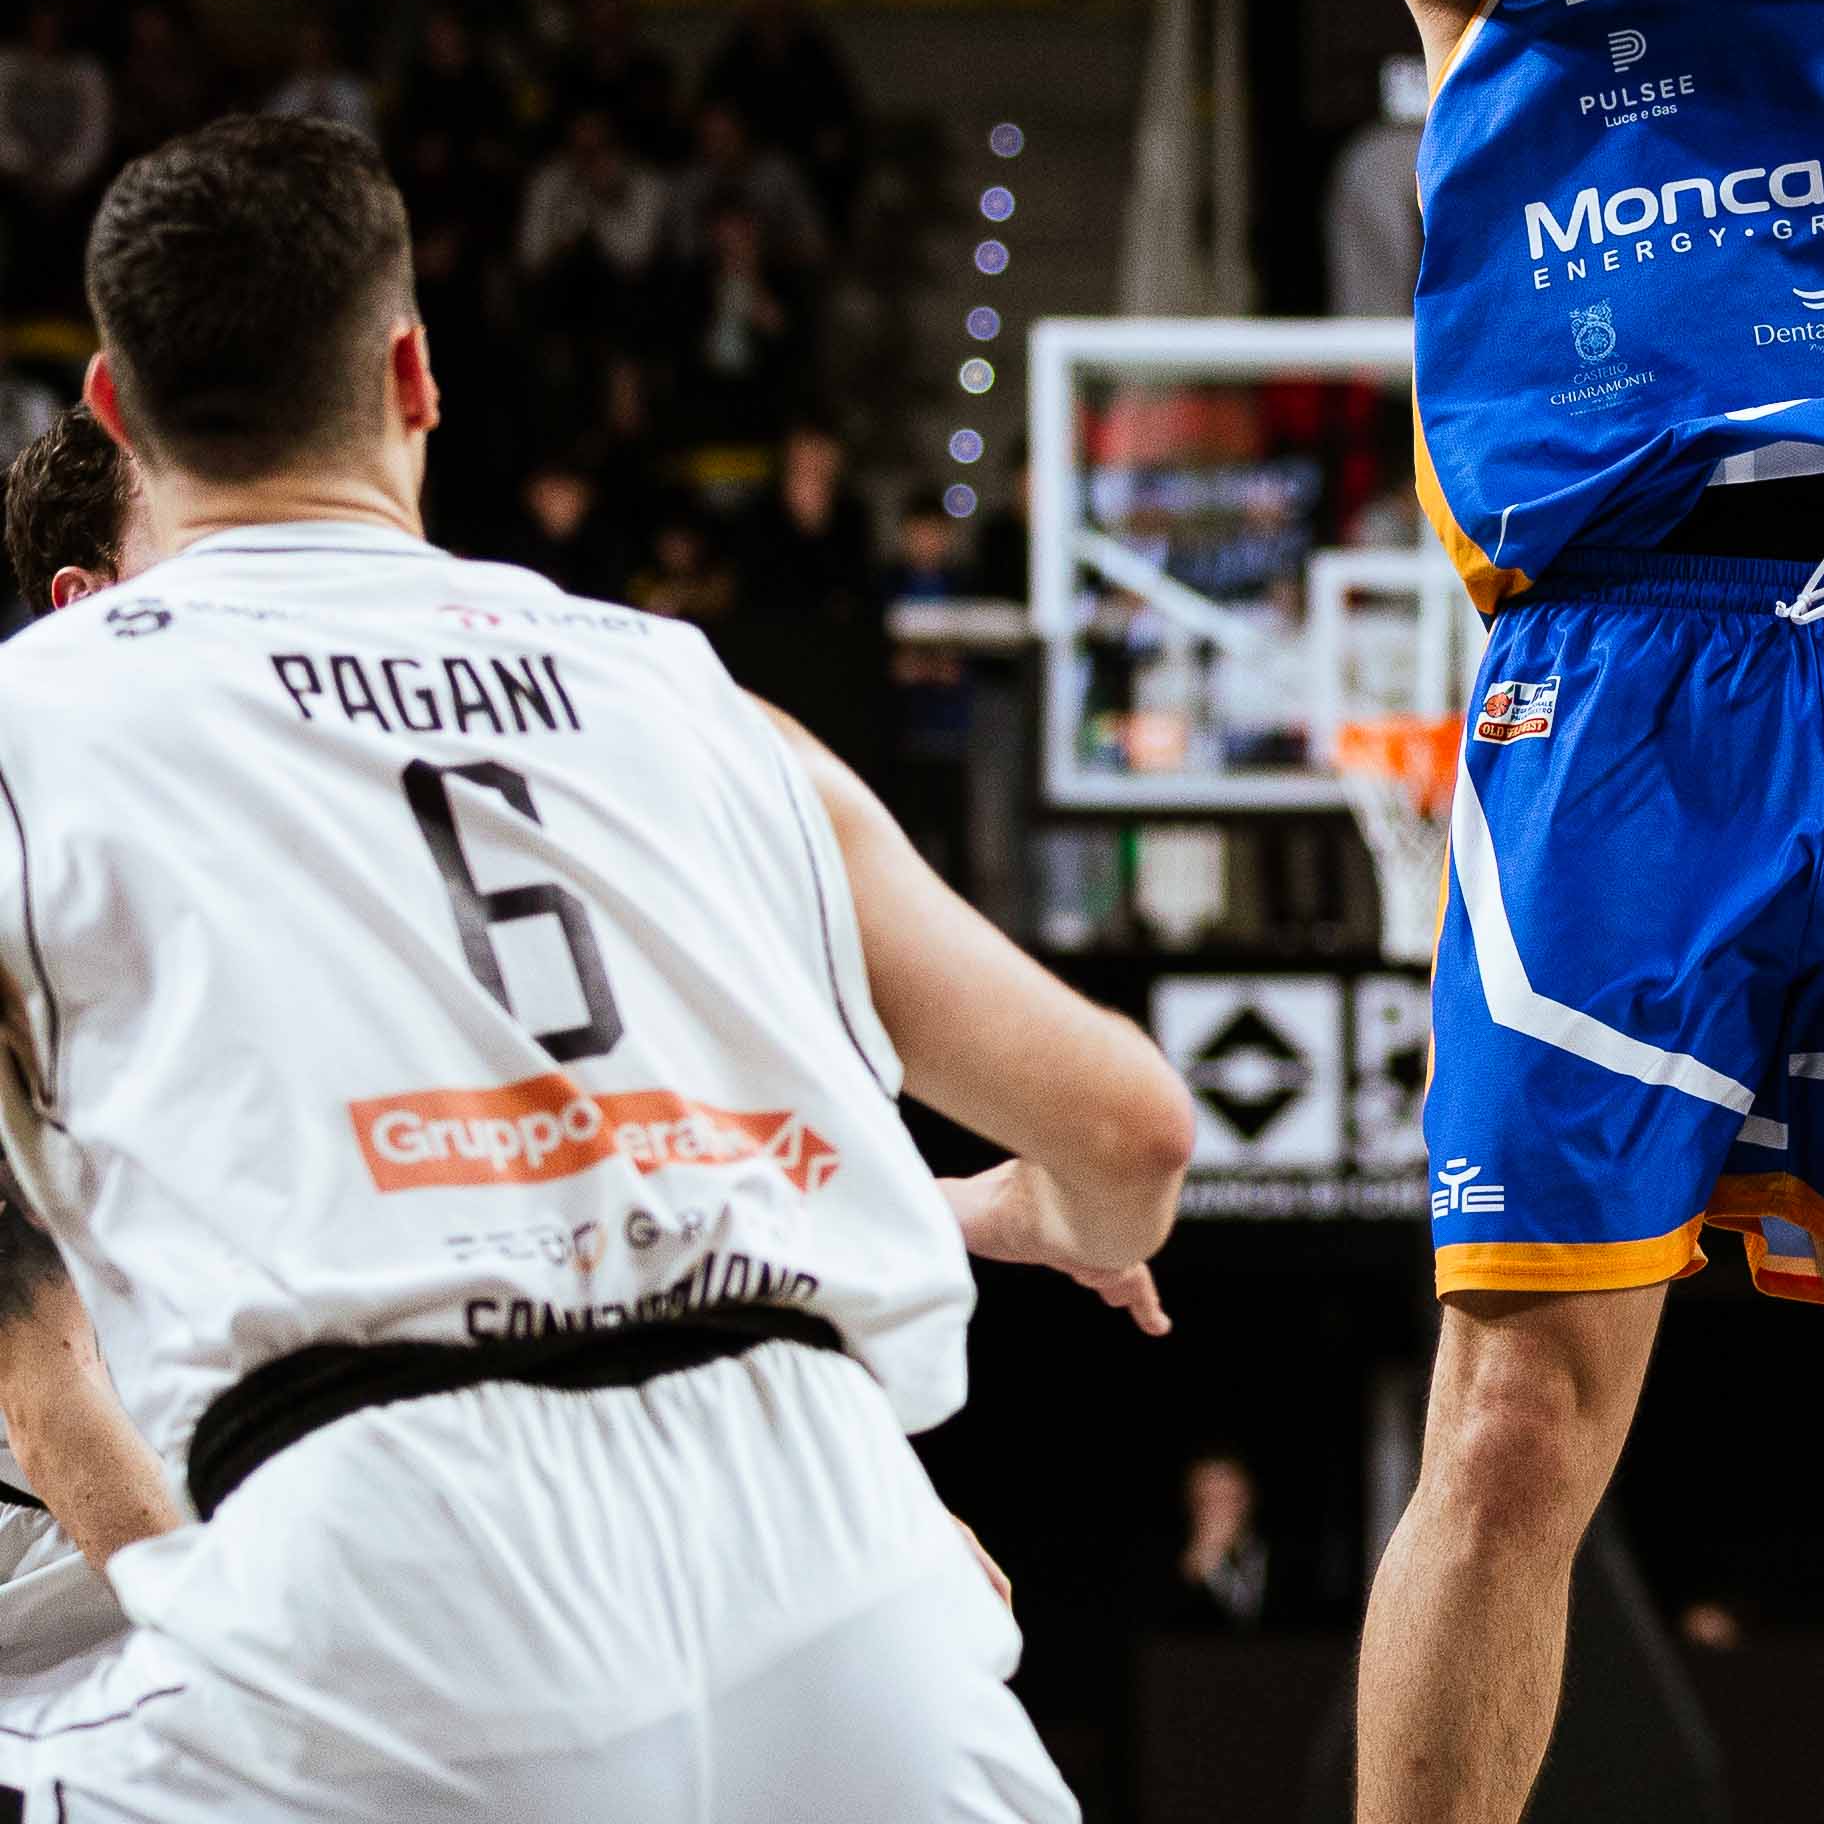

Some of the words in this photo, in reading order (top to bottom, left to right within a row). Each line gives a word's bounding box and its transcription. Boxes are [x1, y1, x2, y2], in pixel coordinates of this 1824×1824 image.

[1579, 74, 1695, 115] PULSEE
[1604, 112, 1638, 128] Luce
[1640, 110, 1649, 120] e
[1651, 104, 1678, 117] Gas
[1534, 227, 1726, 290] ENERGY
[1550, 370, 1657, 406] CHIARAMONTE
[270, 654, 583, 735] PAGANI
[401, 758, 625, 1064] 6
[370, 1094, 603, 1170] Gruppo
